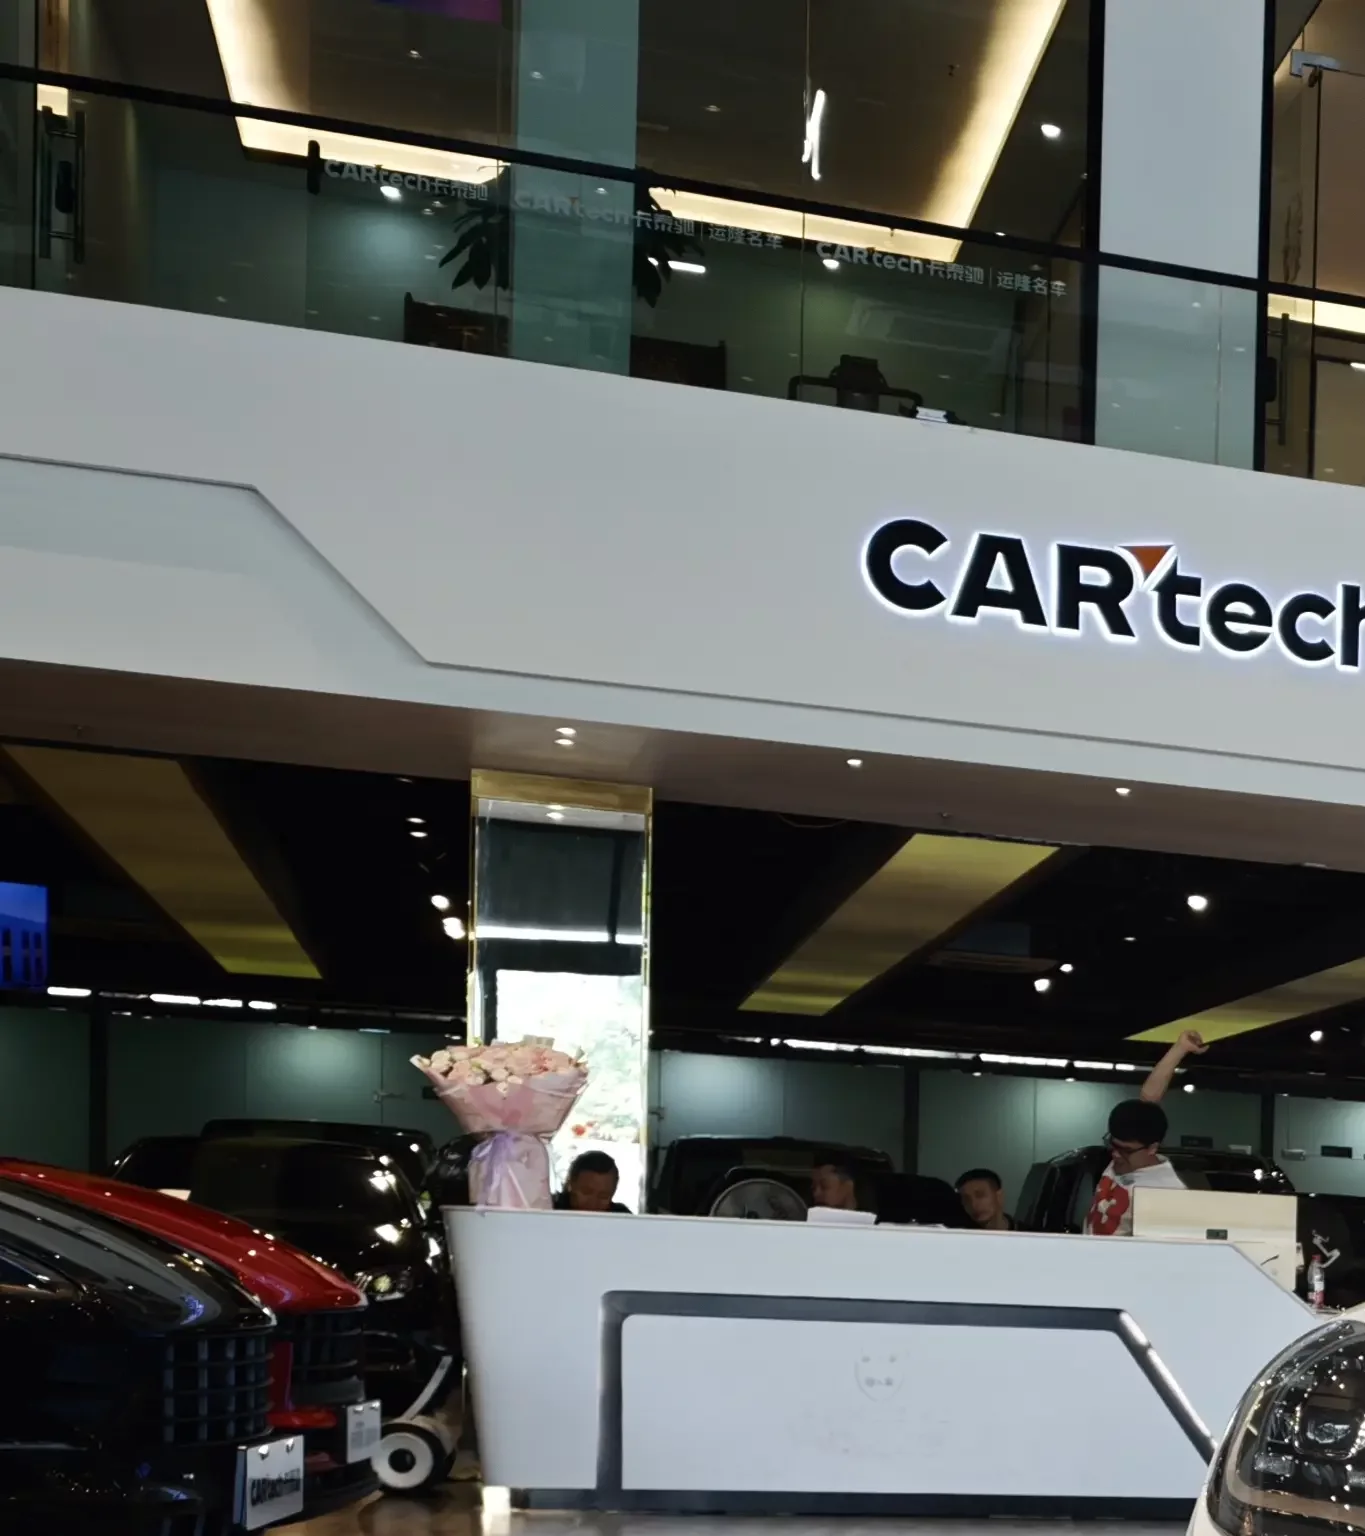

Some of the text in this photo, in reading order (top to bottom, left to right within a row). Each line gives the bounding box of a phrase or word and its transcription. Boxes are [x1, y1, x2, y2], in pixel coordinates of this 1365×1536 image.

[324, 159, 430, 193] CARtech
[708, 223, 784, 250] 运隆名车
[816, 242, 924, 275] CARtech
[996, 271, 1068, 297] 运隆名车
